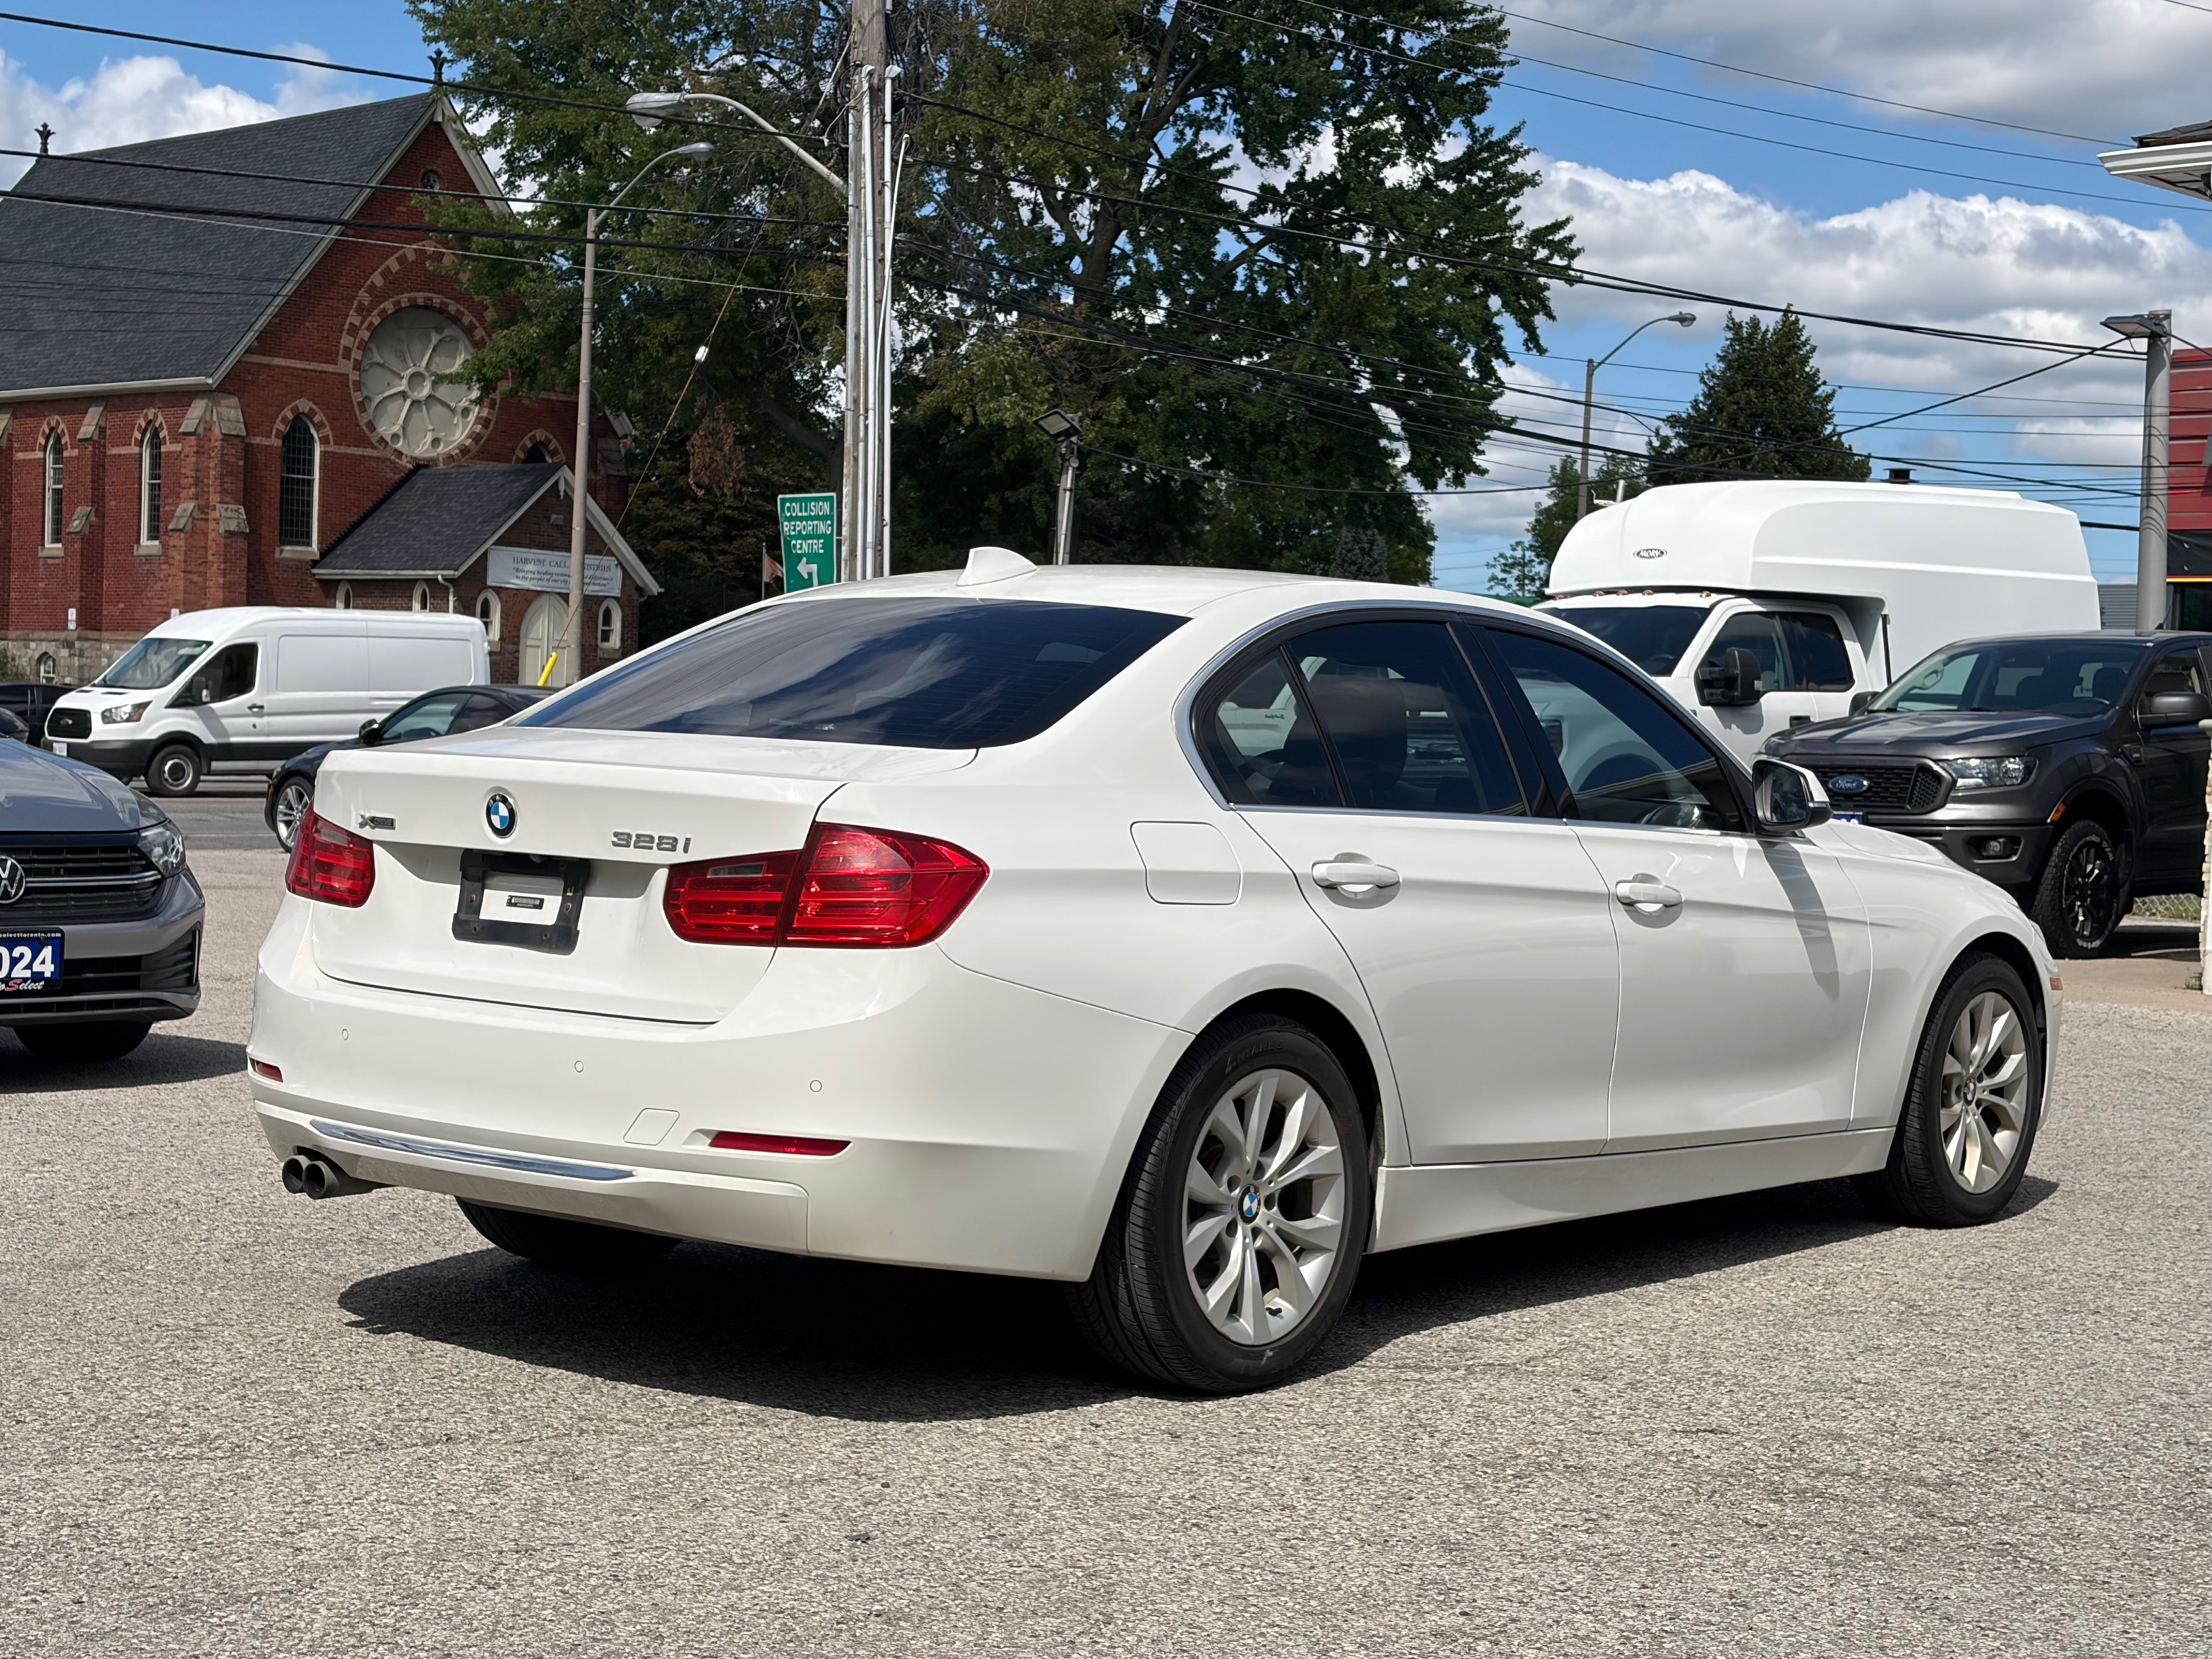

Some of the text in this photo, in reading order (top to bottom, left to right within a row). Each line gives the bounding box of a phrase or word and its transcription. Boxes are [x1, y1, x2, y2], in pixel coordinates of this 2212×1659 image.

[784, 501, 830, 517] COLLISION
[783, 520, 832, 536] REPORTING
[791, 539, 824, 554] CENTRE
[513, 556, 611, 572] HARVEST CALL ISTRIES
[611, 831, 691, 854] 328i
